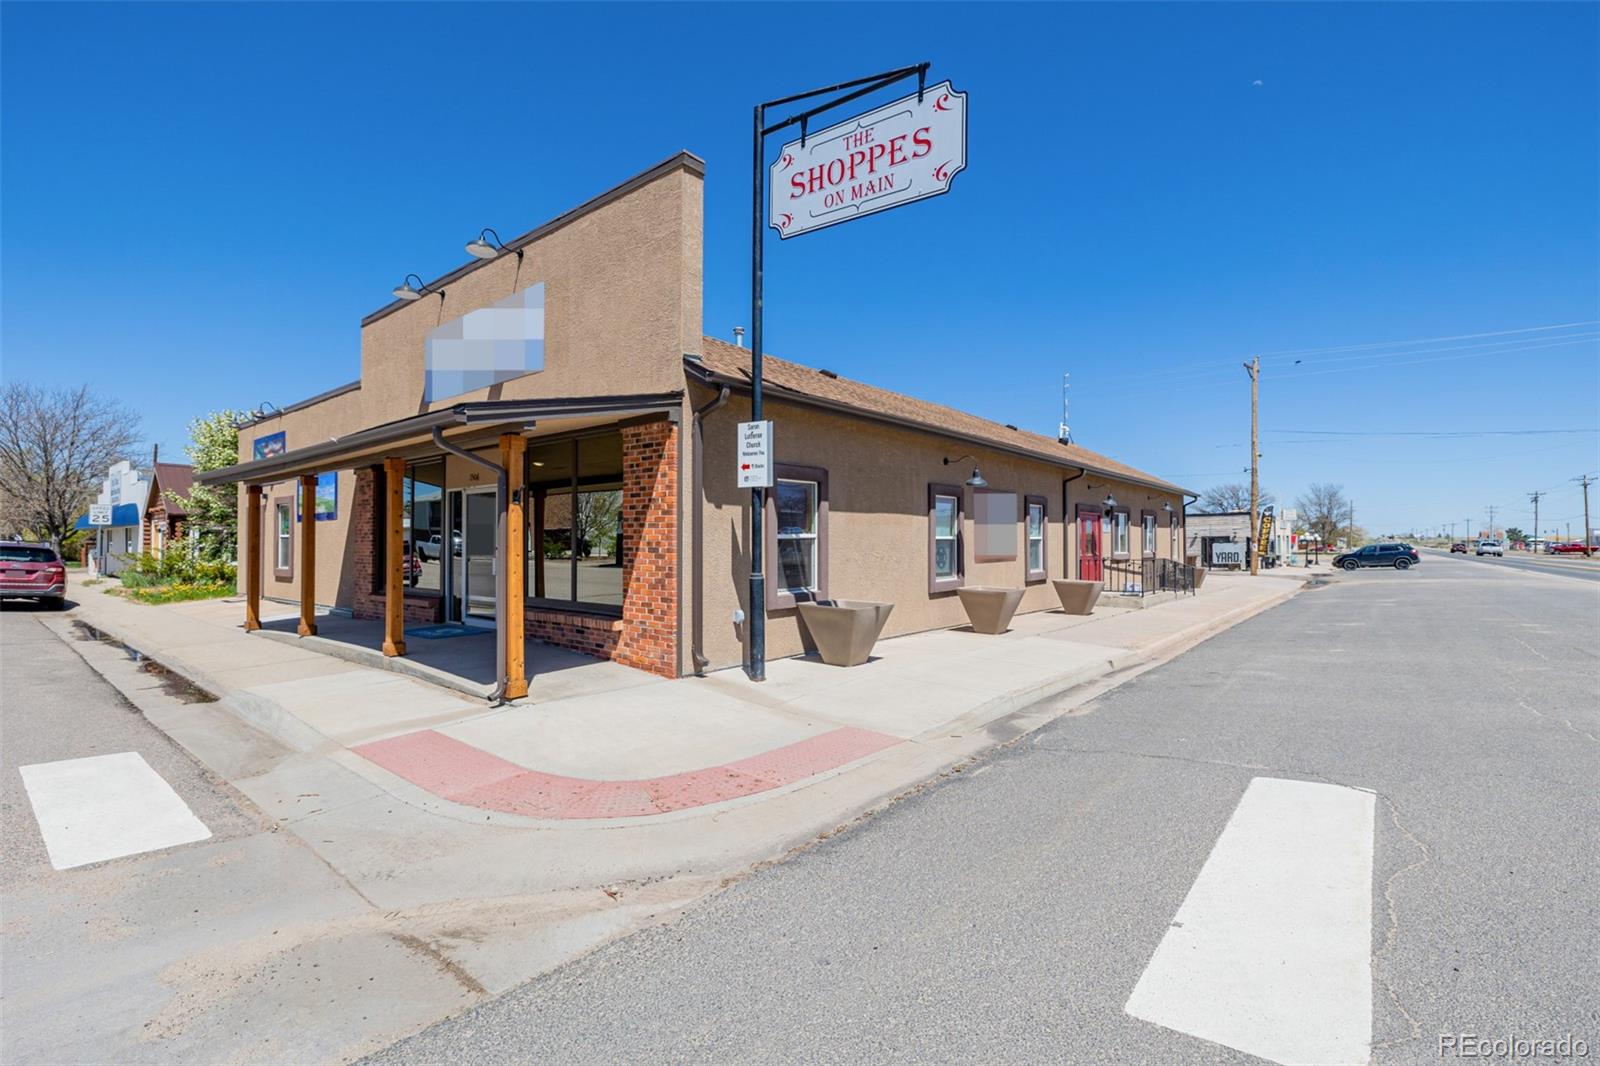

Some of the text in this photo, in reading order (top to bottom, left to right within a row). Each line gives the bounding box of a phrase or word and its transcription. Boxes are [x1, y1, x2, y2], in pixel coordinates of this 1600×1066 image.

[843, 127, 875, 151] THE
[790, 126, 933, 201] SHOPPES
[824, 173, 895, 208] ON MAIN
[744, 432, 763, 440] Lutheran
[92, 514, 110, 523] 25
